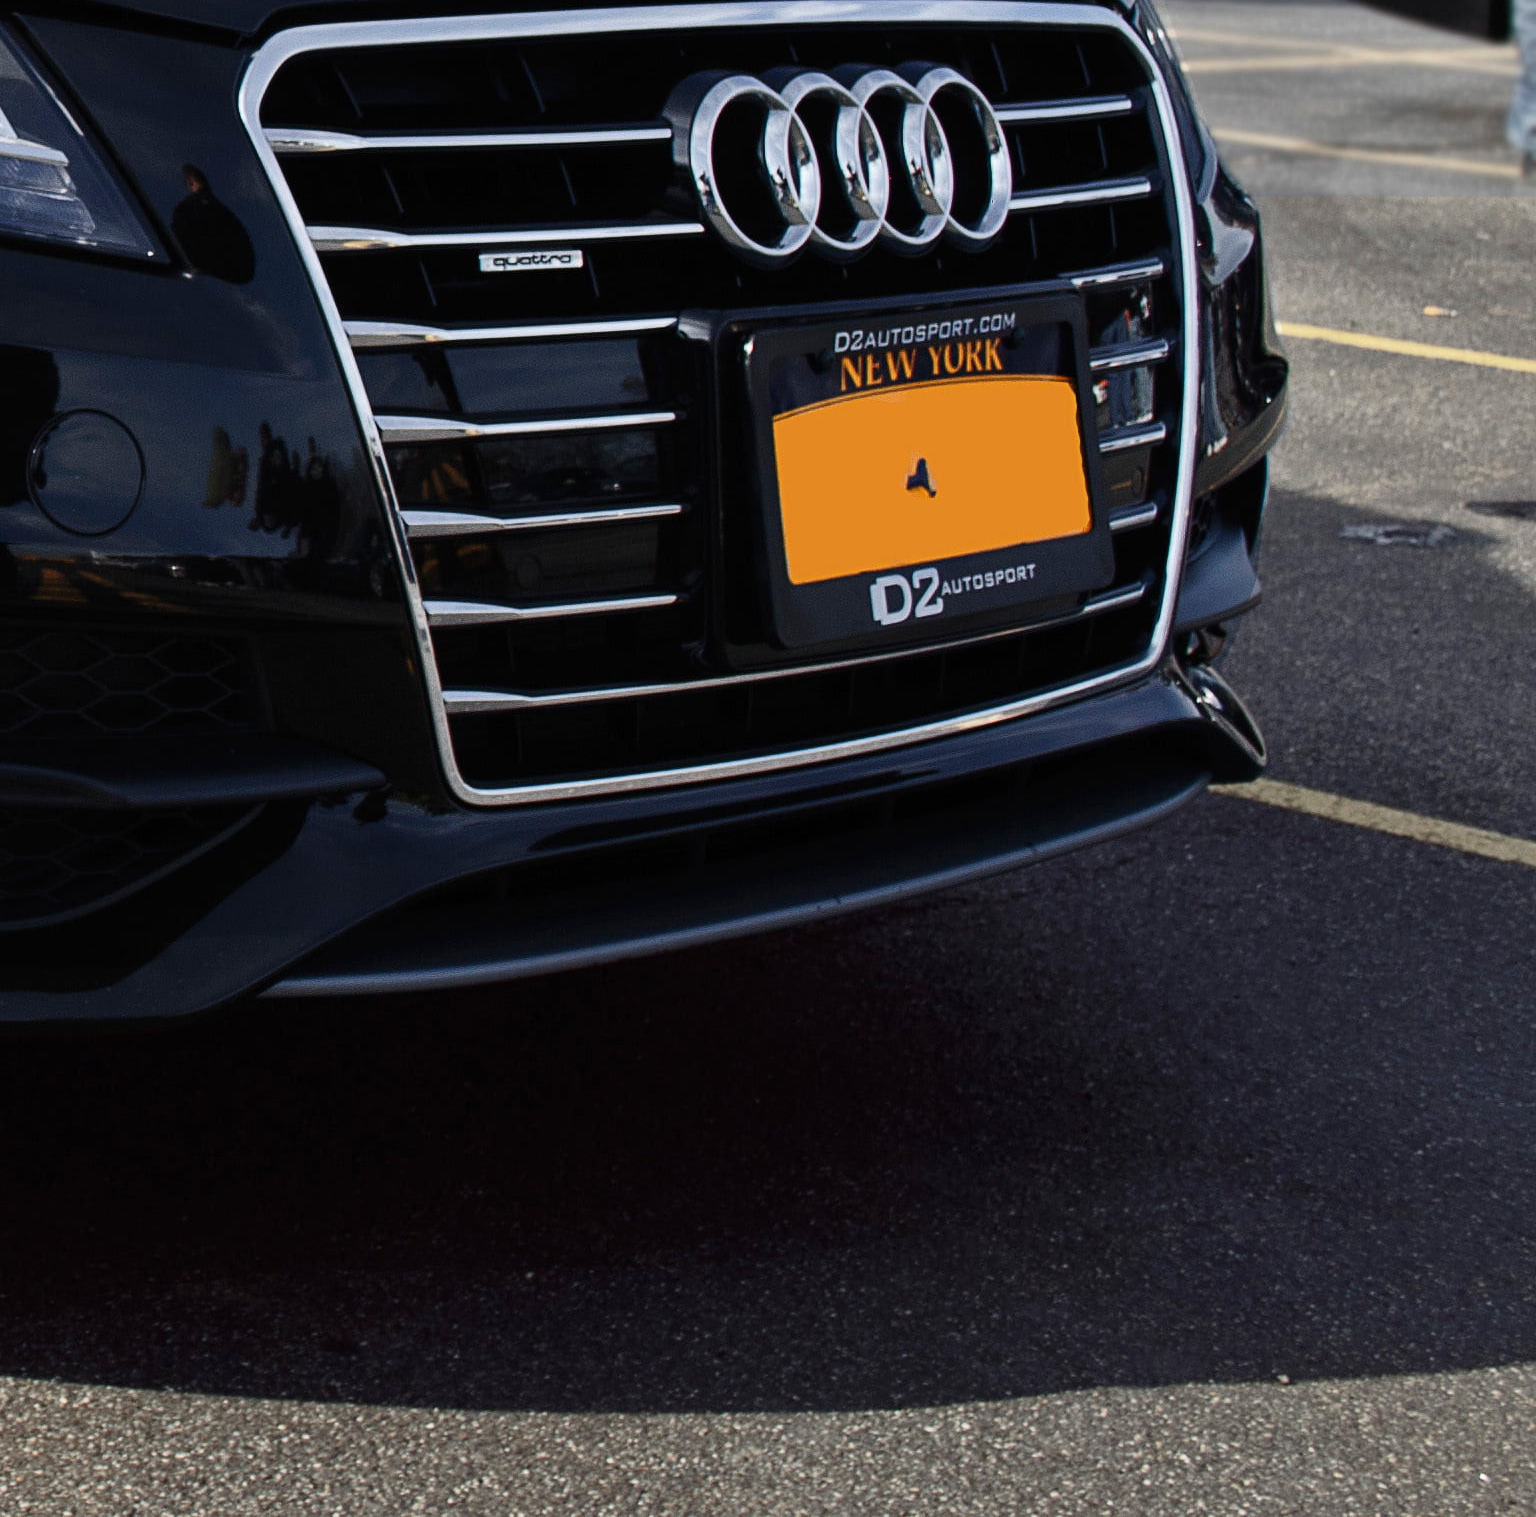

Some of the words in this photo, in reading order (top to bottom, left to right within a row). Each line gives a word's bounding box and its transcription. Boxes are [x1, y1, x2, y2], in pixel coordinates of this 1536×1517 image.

[493, 254, 571, 269] quattro
[834, 312, 1016, 353] D2AUTOSPORT.COM
[841, 349, 918, 391] NEW
[929, 337, 1004, 376] YORK
[870, 567, 944, 626] D2
[941, 564, 1036, 597] AUTOSPORT
